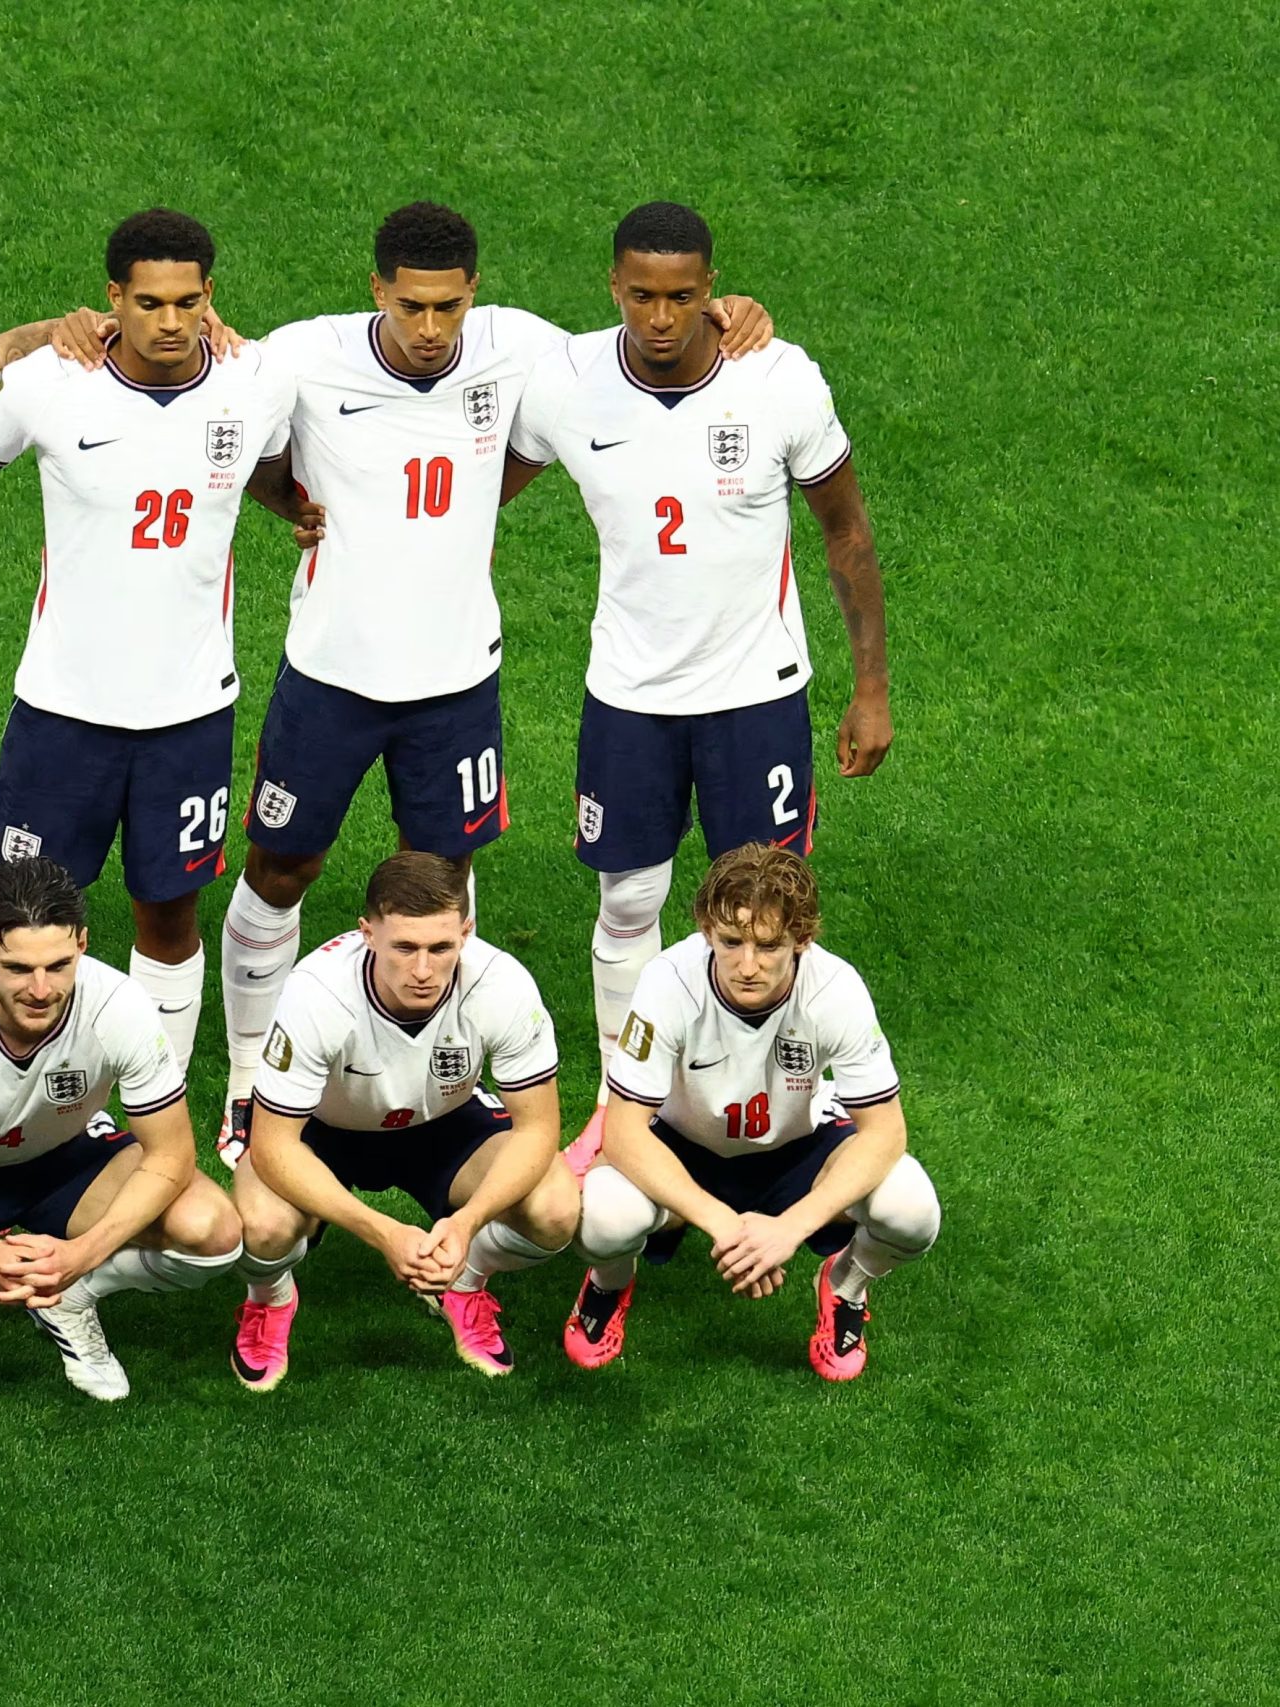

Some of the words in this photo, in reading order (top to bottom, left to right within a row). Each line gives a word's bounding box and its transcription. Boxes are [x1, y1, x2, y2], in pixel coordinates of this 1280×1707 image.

[475, 434, 498, 445] MEXICO
[210, 471, 236, 481] MEXICO
[404, 456, 453, 519] 10
[717, 478, 745, 486] MEXICO
[132, 488, 193, 549] 26
[654, 496, 688, 555] 2
[456, 746, 498, 814] 10
[767, 763, 798, 826] 2
[179, 786, 228, 853] 26
[380, 1107, 415, 1129] 8
[724, 1091, 771, 1139] 18
